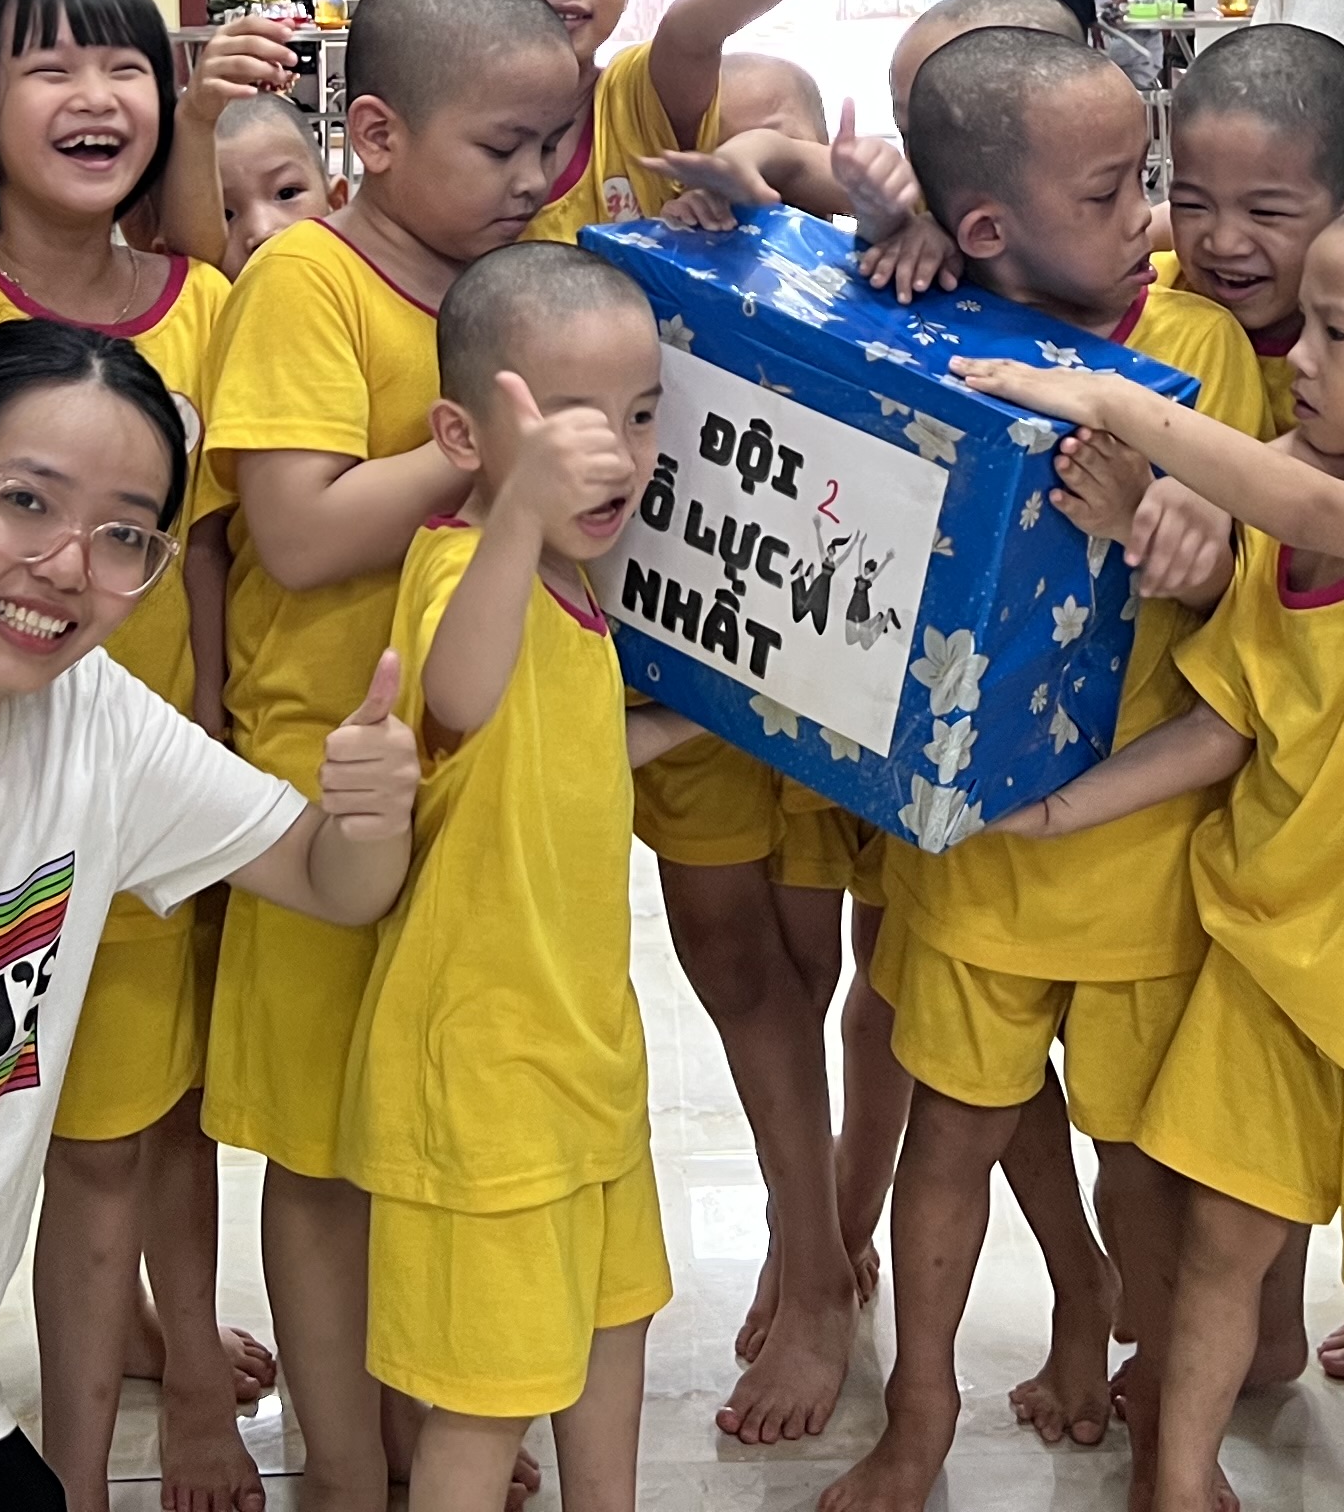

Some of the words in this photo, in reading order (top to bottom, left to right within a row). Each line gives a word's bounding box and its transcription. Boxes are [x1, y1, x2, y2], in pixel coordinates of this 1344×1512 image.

[699, 412, 804, 500] ĐỘI
[636, 452, 678, 532] Ỗ
[684, 499, 790, 589] LỰC
[818, 479, 840, 524] 2
